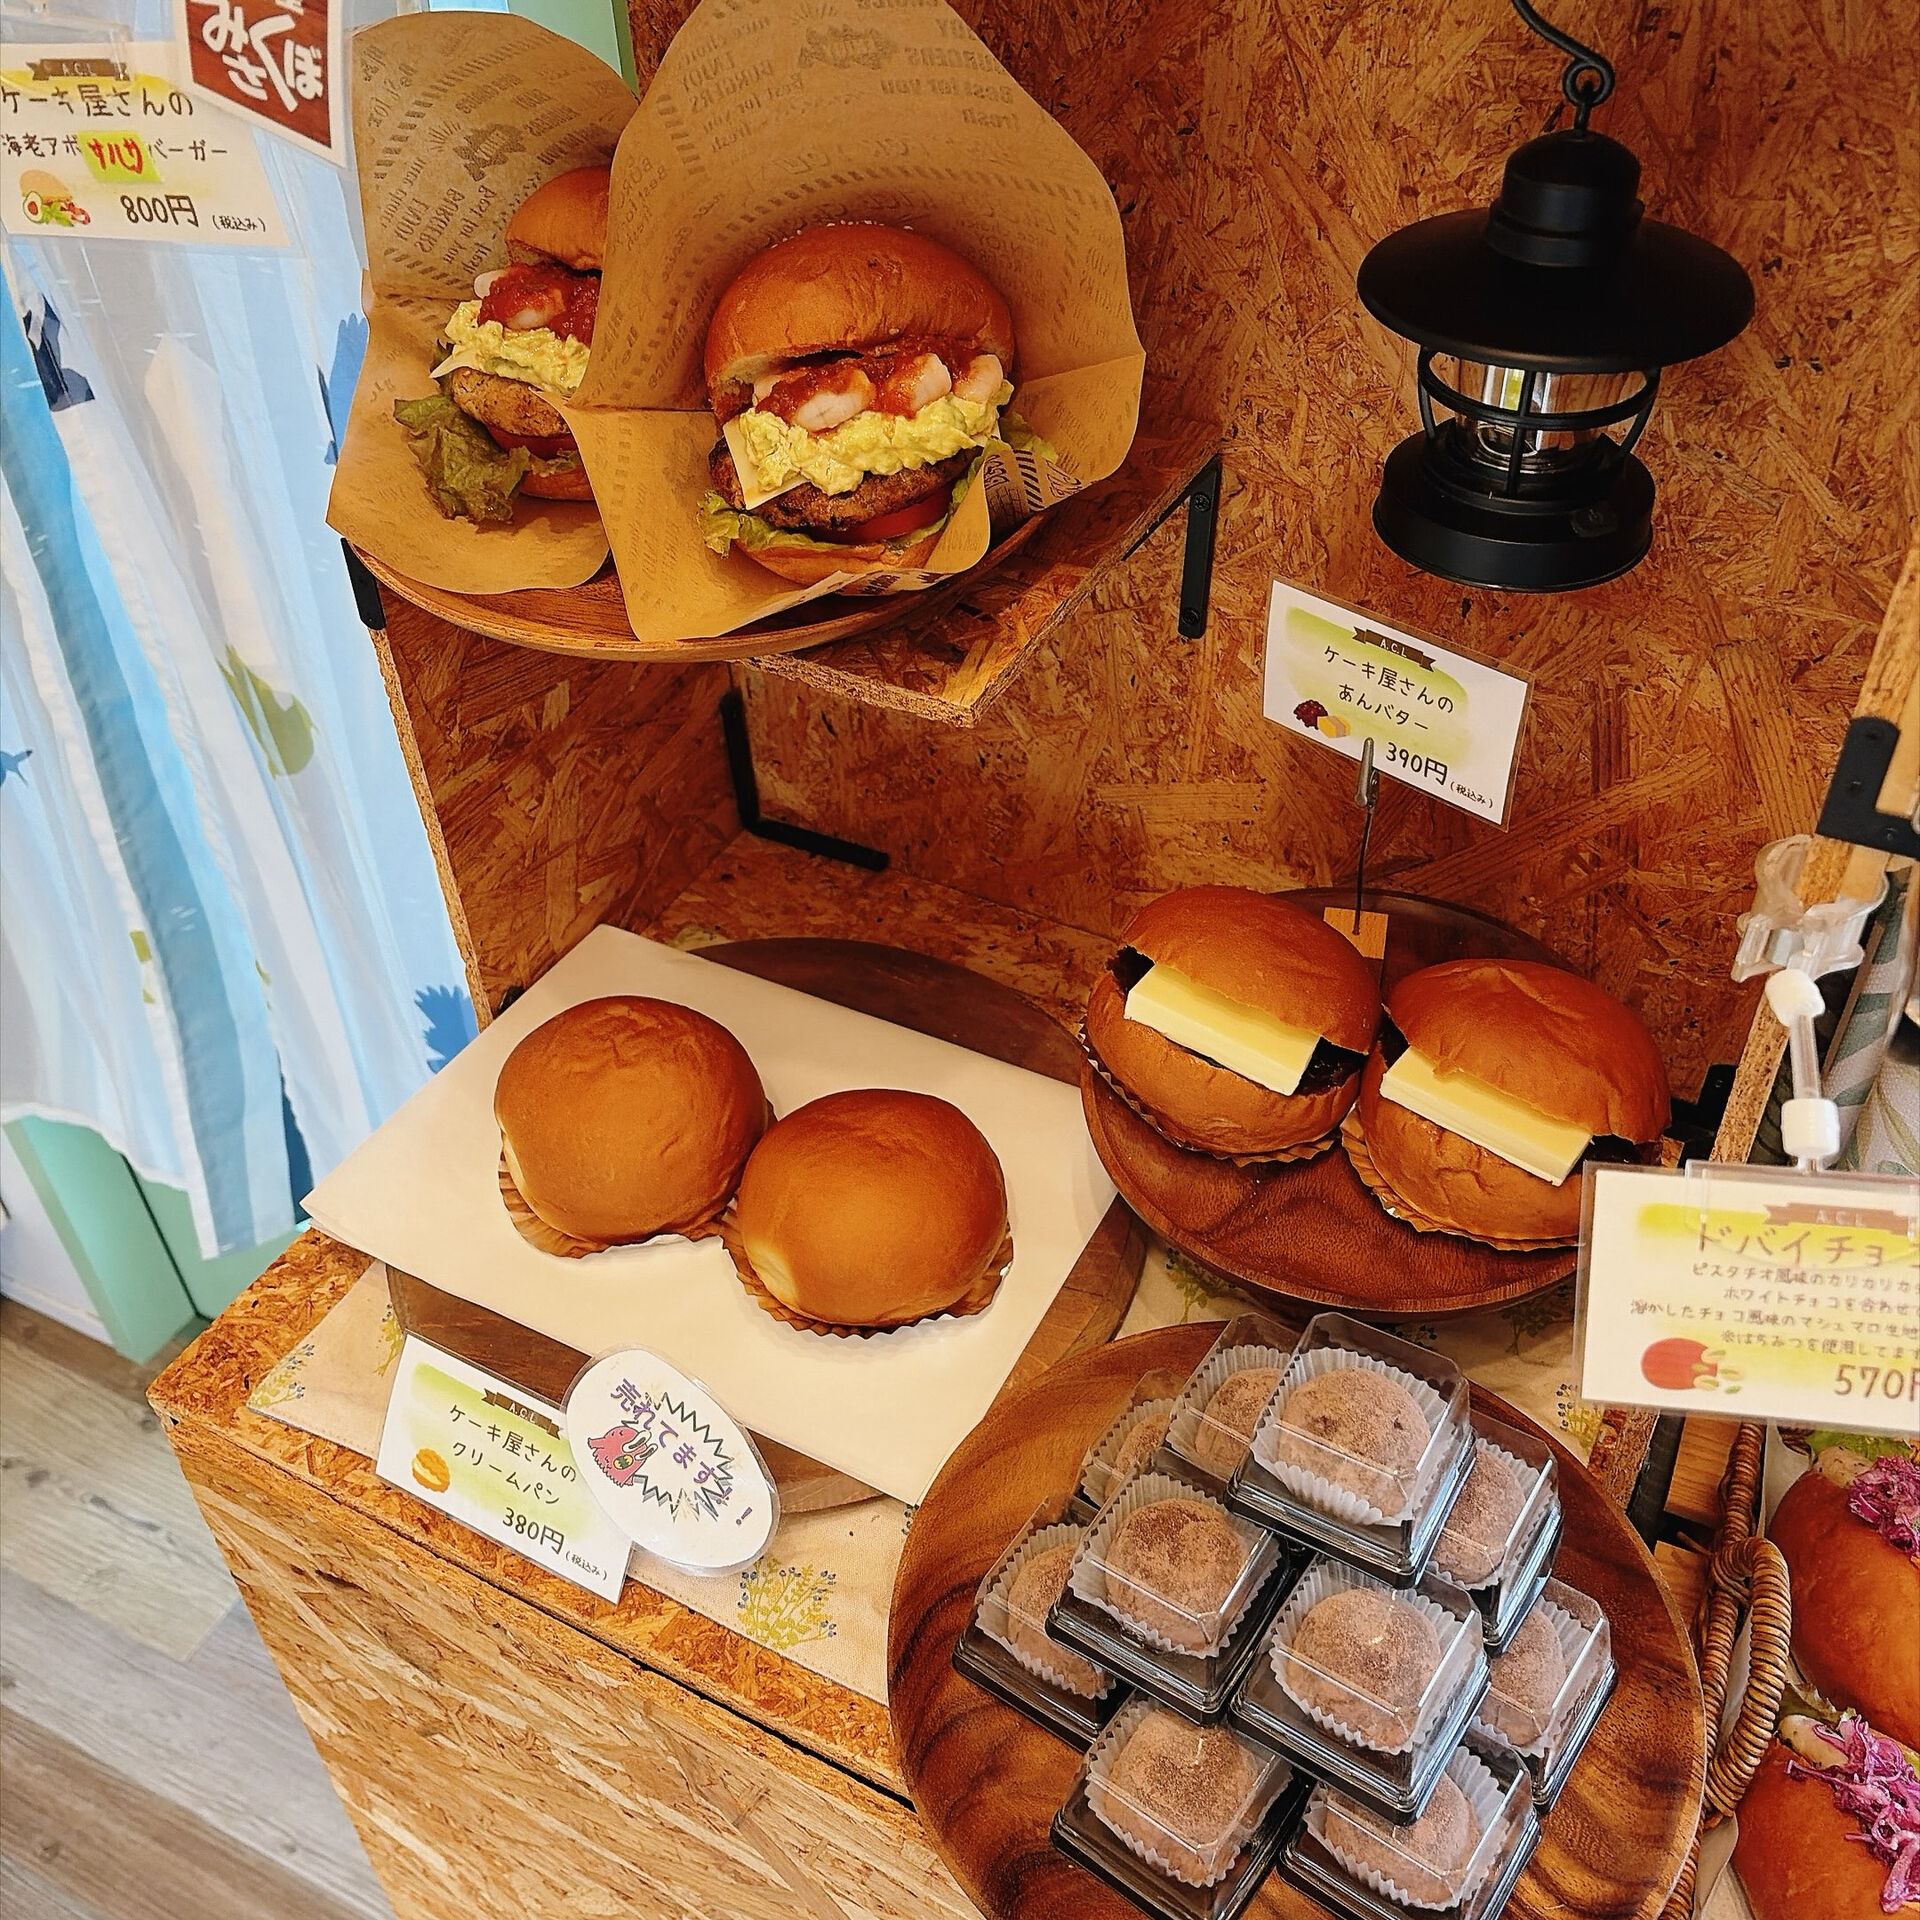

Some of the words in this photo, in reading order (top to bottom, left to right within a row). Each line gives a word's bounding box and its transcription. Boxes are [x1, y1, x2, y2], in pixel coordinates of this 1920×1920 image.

[1, 84, 194, 117] ケーキ屋さんの
[120, 193, 199, 228] 800円
[1323, 645, 1454, 714] ケーキ屋さんの
[1338, 683, 1429, 731] あんバター
[1385, 741, 1449, 786] 390円
[1692, 1262, 1920, 1296] ピスタチオ風味のカリカリな
[1723, 1286, 1920, 1317] ホワイトチョコを合わせ
[449, 1404, 577, 1484] ケーキ屋さんの
[452, 1442, 561, 1506] クリームパン
[502, 1507, 566, 1556] 380円
